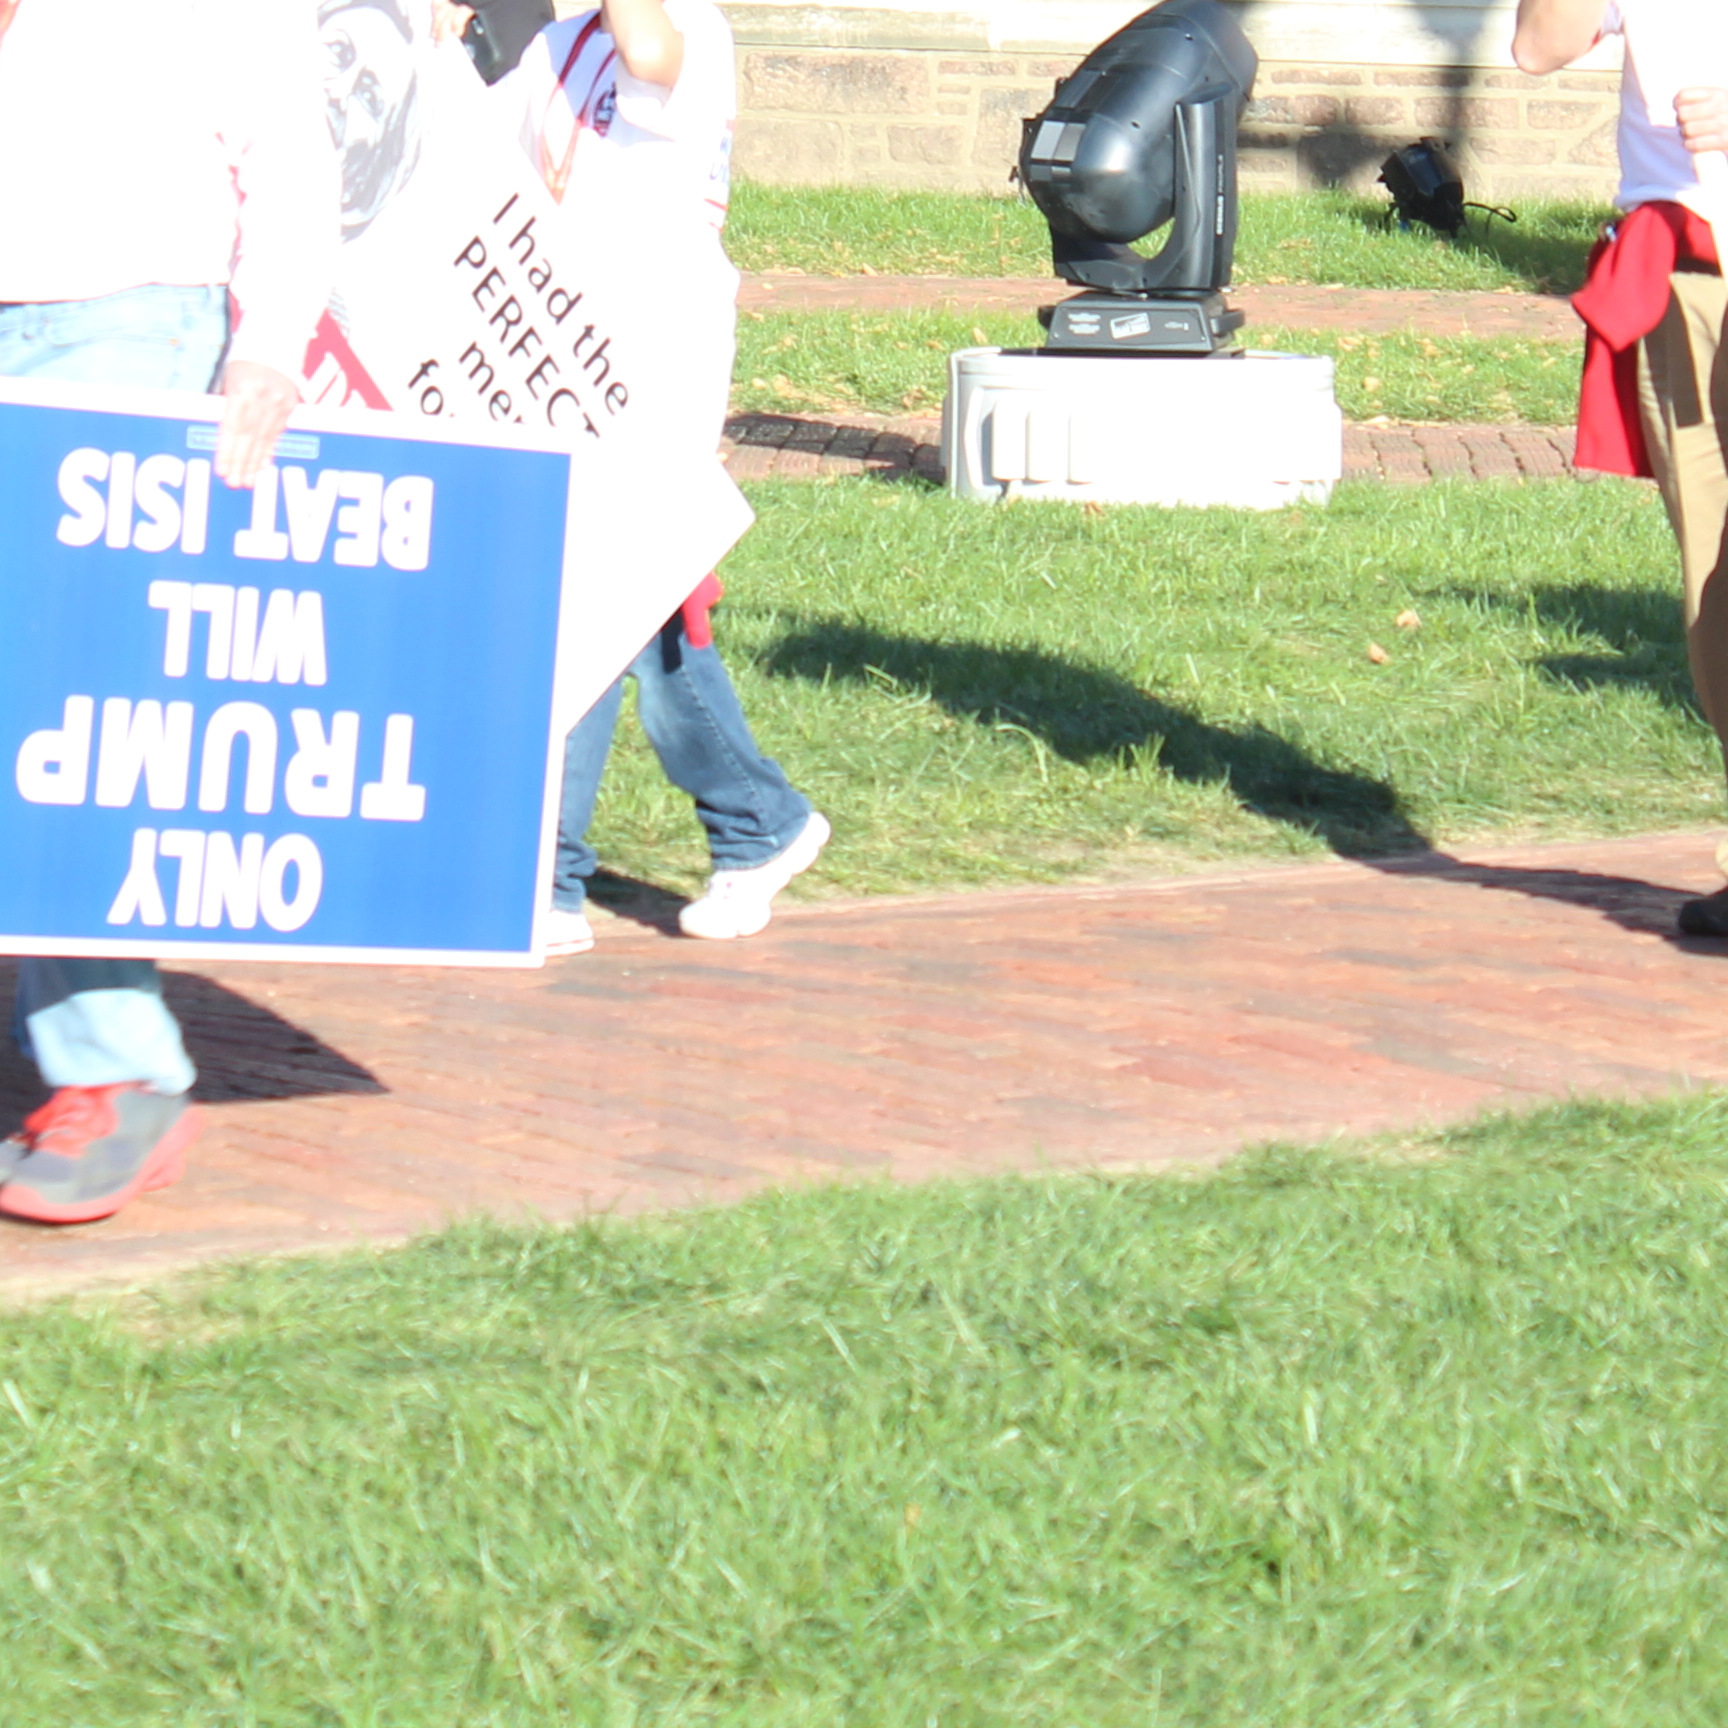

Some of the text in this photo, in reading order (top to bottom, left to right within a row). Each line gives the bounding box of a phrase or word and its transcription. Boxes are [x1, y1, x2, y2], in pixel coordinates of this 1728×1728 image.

[492, 192, 629, 417] I had the
[56, 447, 434, 571] BEAT ISIS
[148, 580, 327, 686] WILL
[15, 695, 426, 821] TRUMP
[105, 827, 323, 932] ONLY
